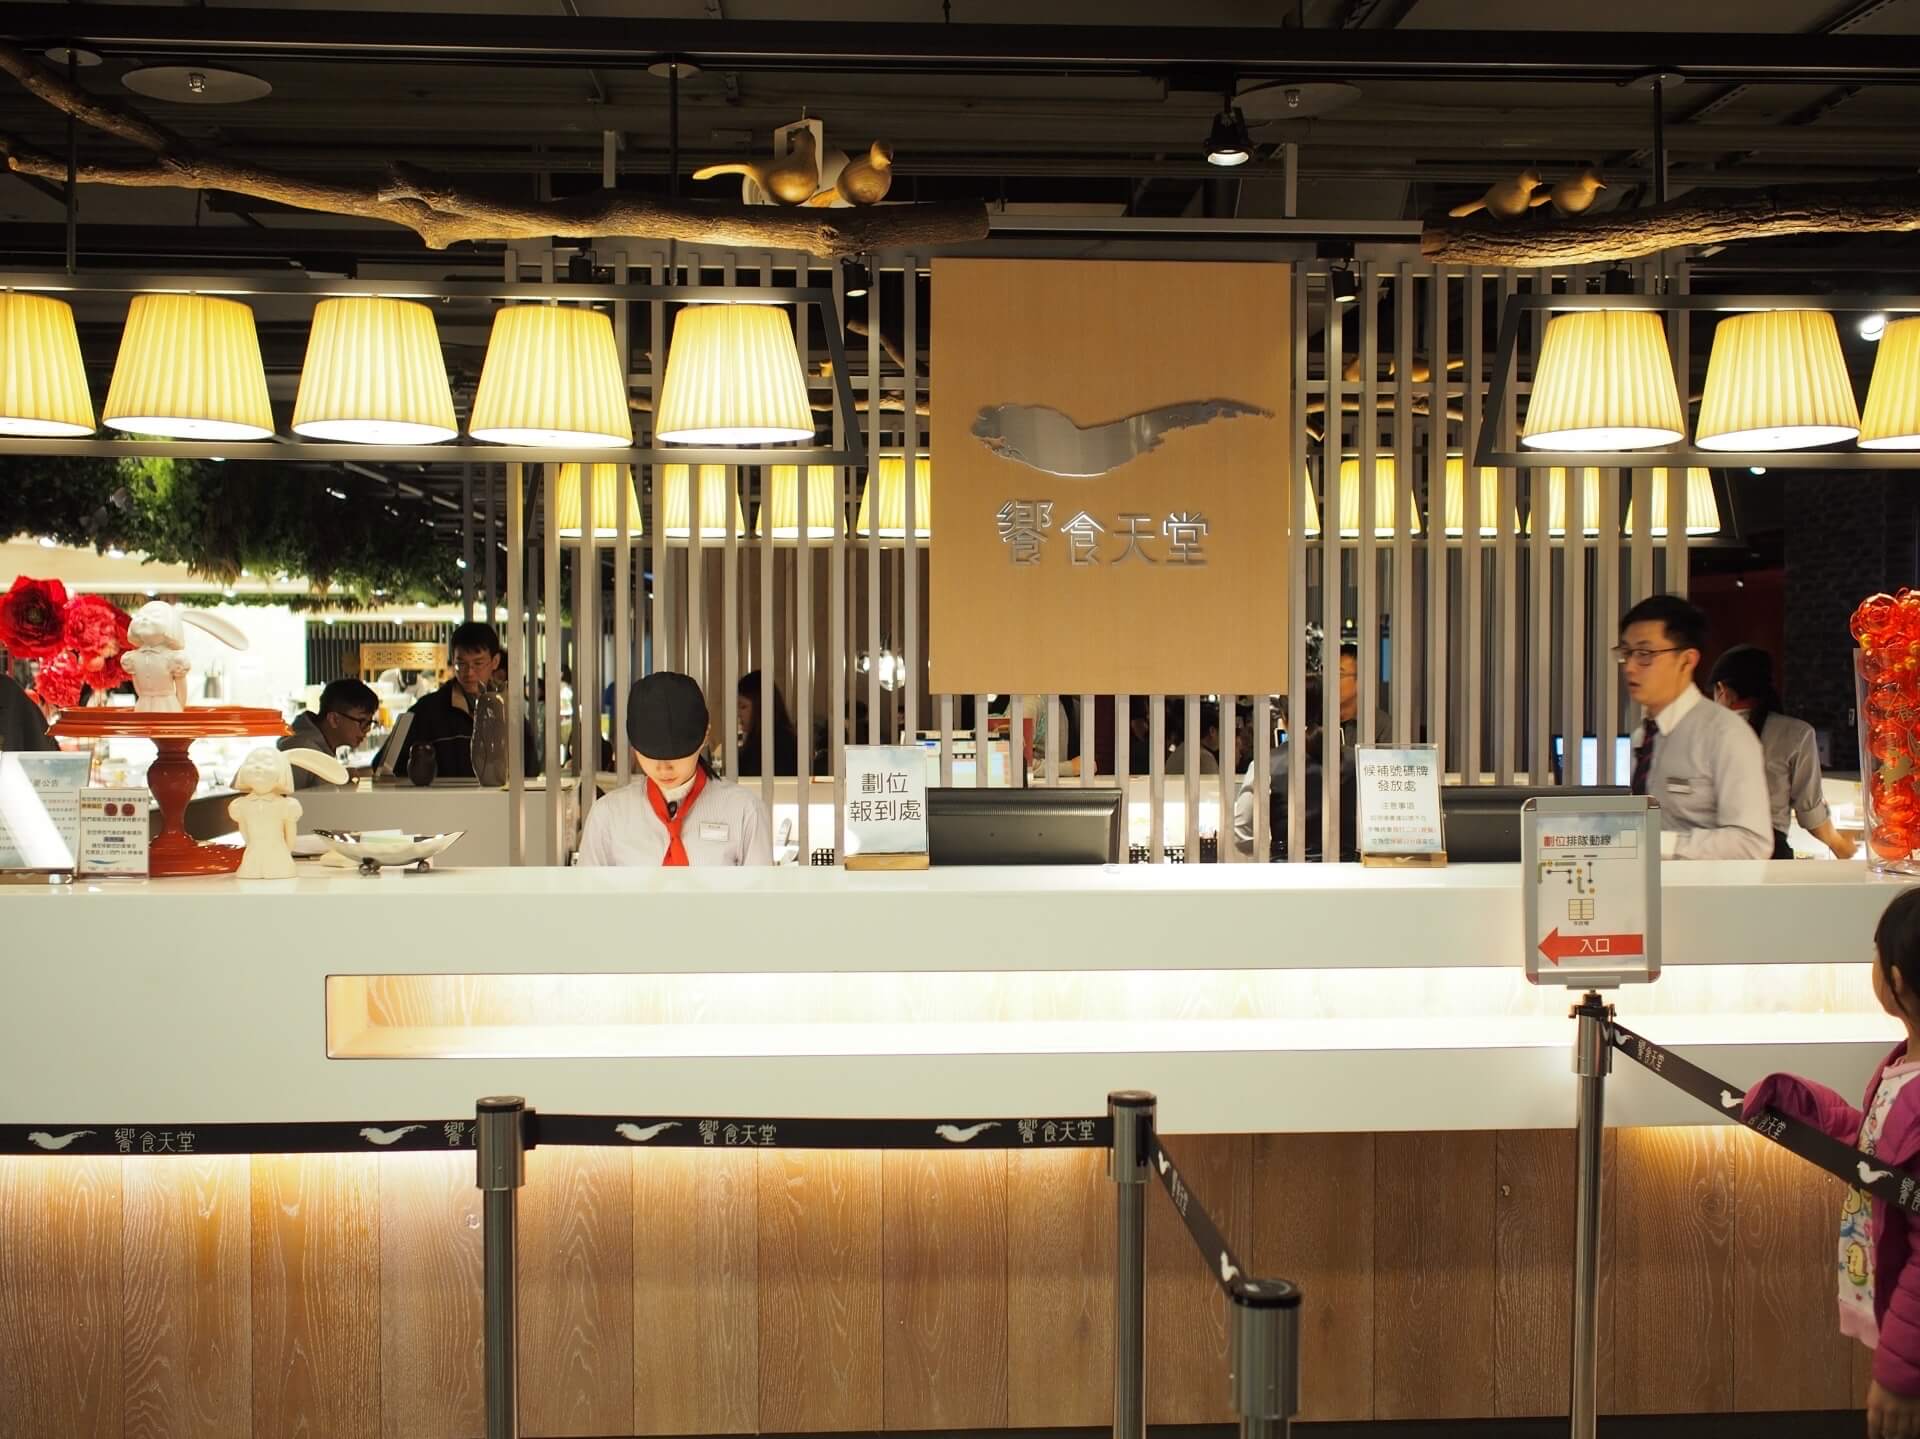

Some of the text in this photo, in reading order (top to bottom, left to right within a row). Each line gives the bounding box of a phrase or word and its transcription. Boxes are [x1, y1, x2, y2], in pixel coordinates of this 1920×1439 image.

[996, 500, 1208, 566] 饗食天堂
[1364, 764, 1429, 777] 候補號碼牌
[861, 772, 908, 793] 劃位
[1378, 780, 1417, 792] 發放處
[850, 800, 921, 821] 報到處
[1543, 835, 1611, 847] 劃位排隊動線
[1580, 939, 1610, 952] 入口
[114, 1127, 195, 1152] 饗食天堂
[698, 1119, 777, 1145] 饗食天堂
[1017, 1119, 1095, 1143] 饗食天堂
